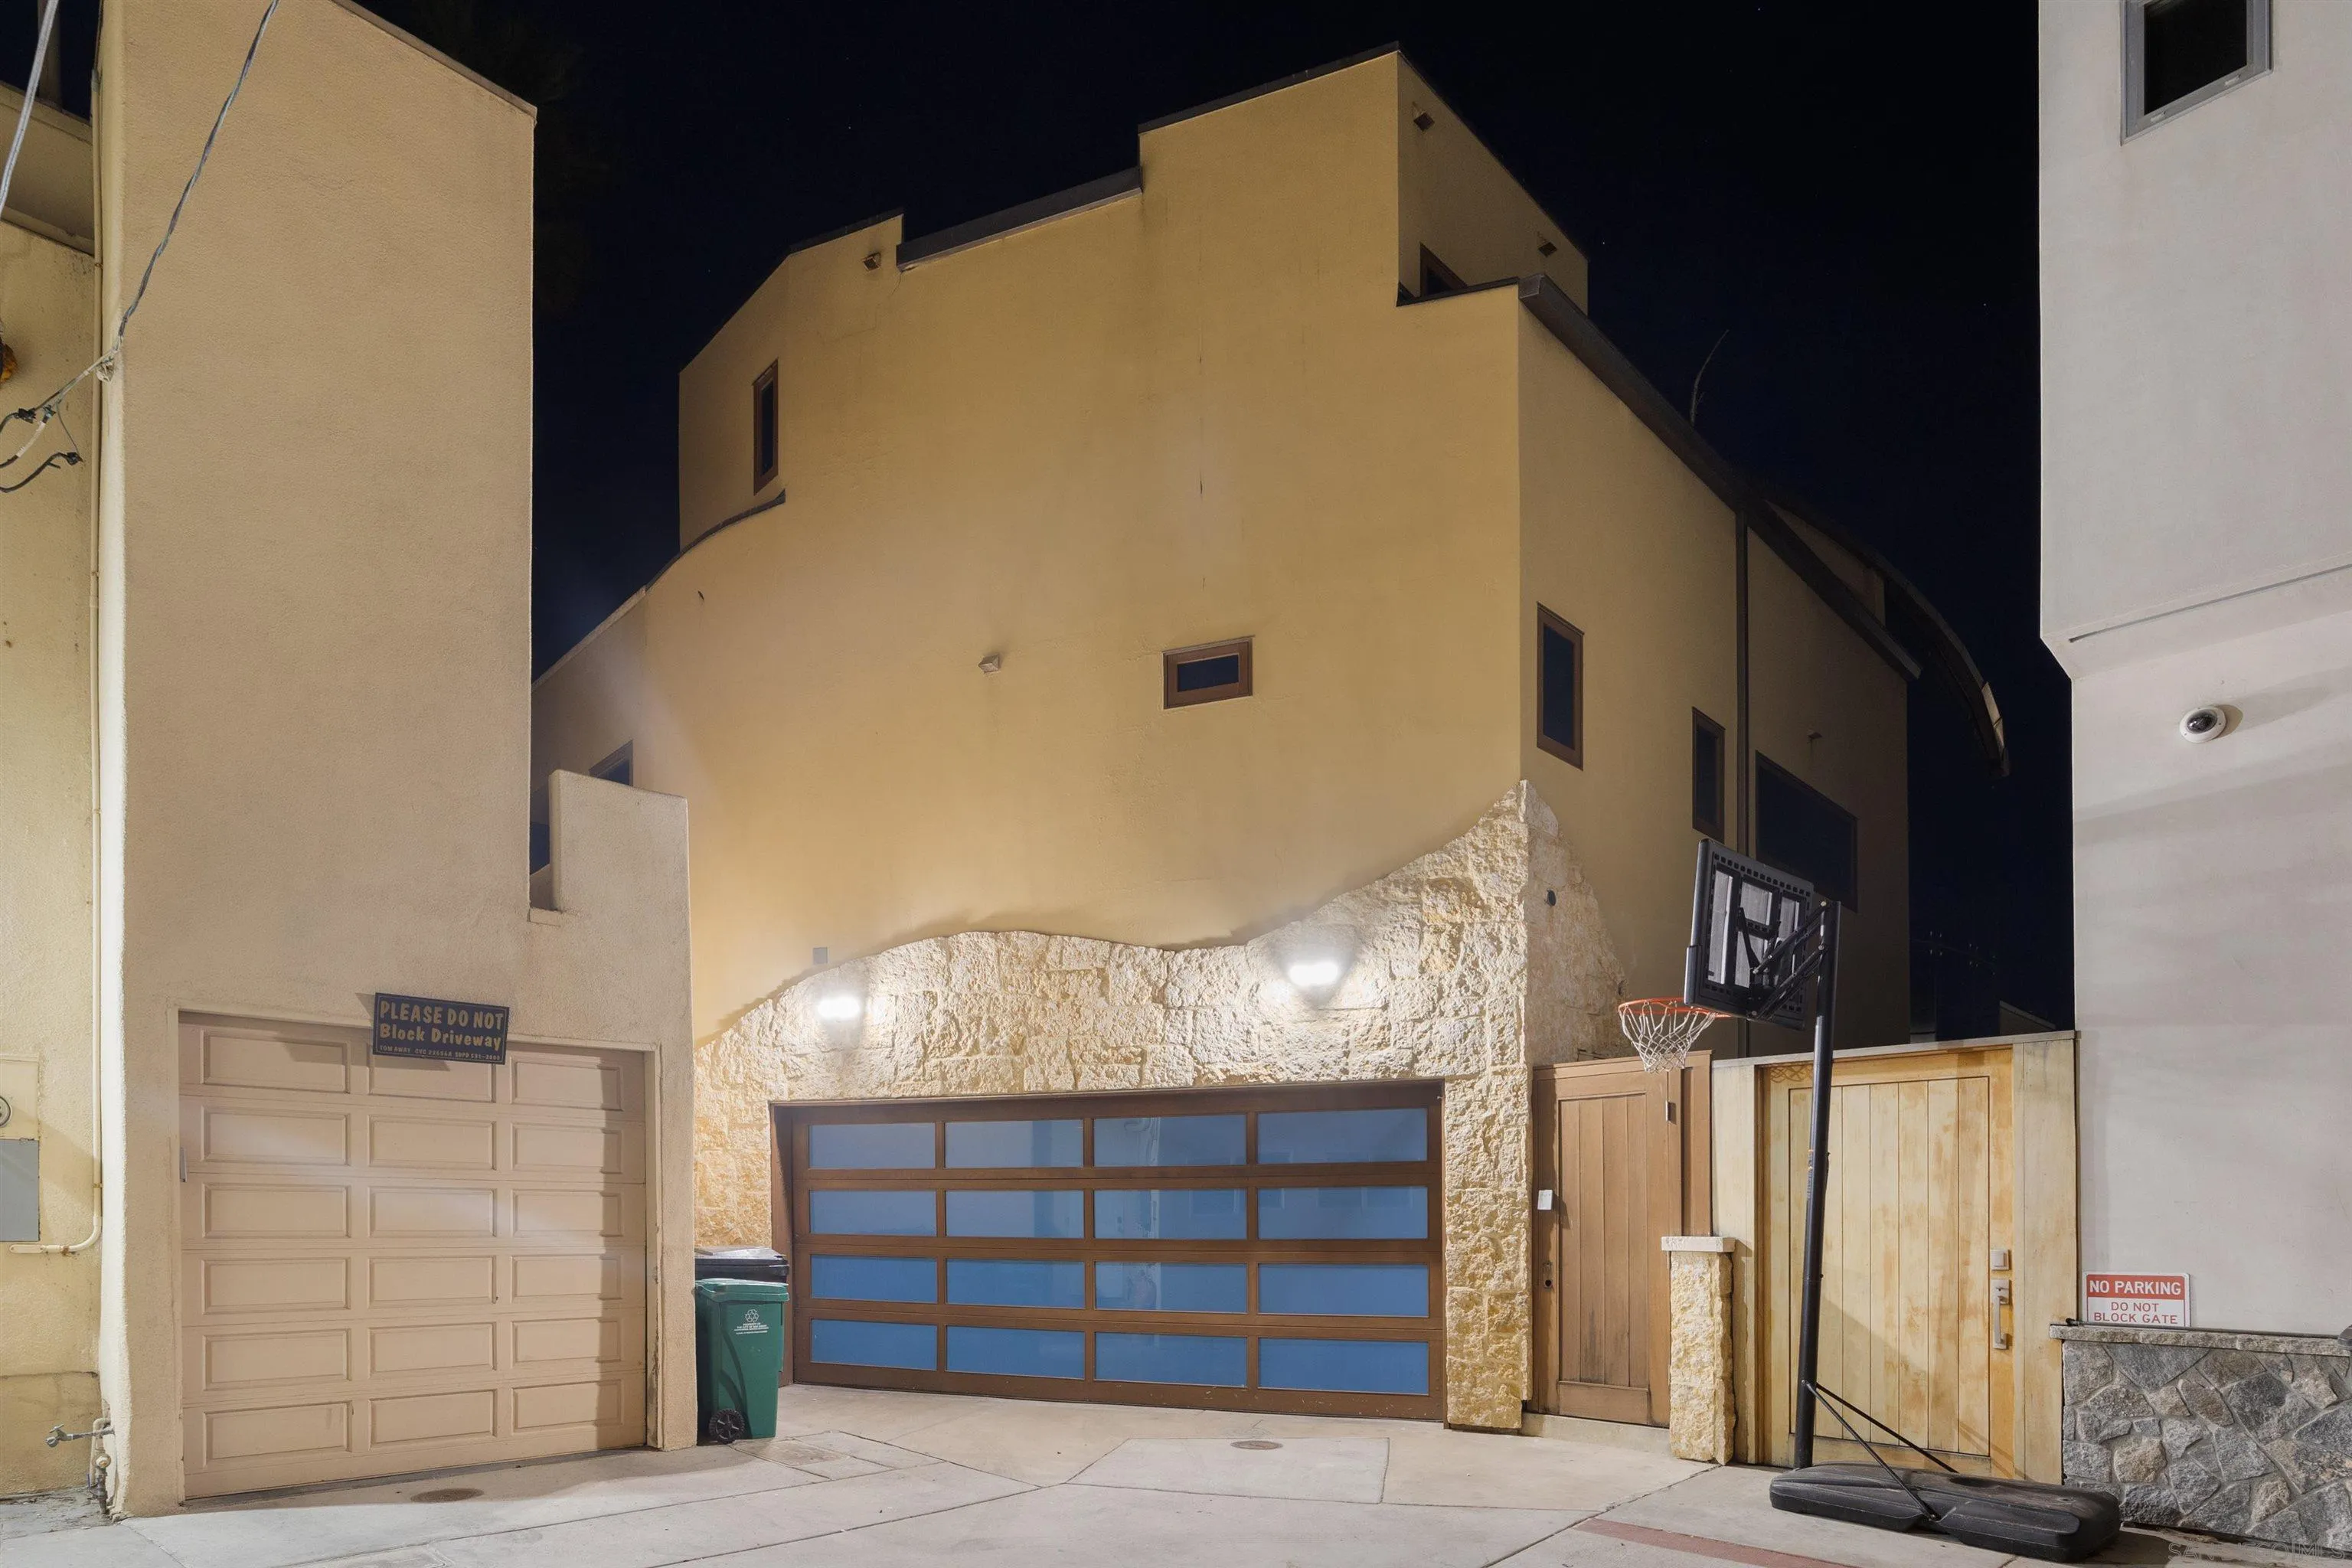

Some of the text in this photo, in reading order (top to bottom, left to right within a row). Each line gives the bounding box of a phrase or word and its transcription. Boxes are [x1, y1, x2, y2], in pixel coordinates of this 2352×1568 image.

[380, 1001, 504, 1031] PLEASE DO NOT
[380, 1023, 501, 1051] Block Driveway
[2089, 1280, 2181, 1295] NO PARKING
[2111, 1302, 2159, 1312] DO NOT
[2094, 1312, 2177, 1325] BLOCK GATE
